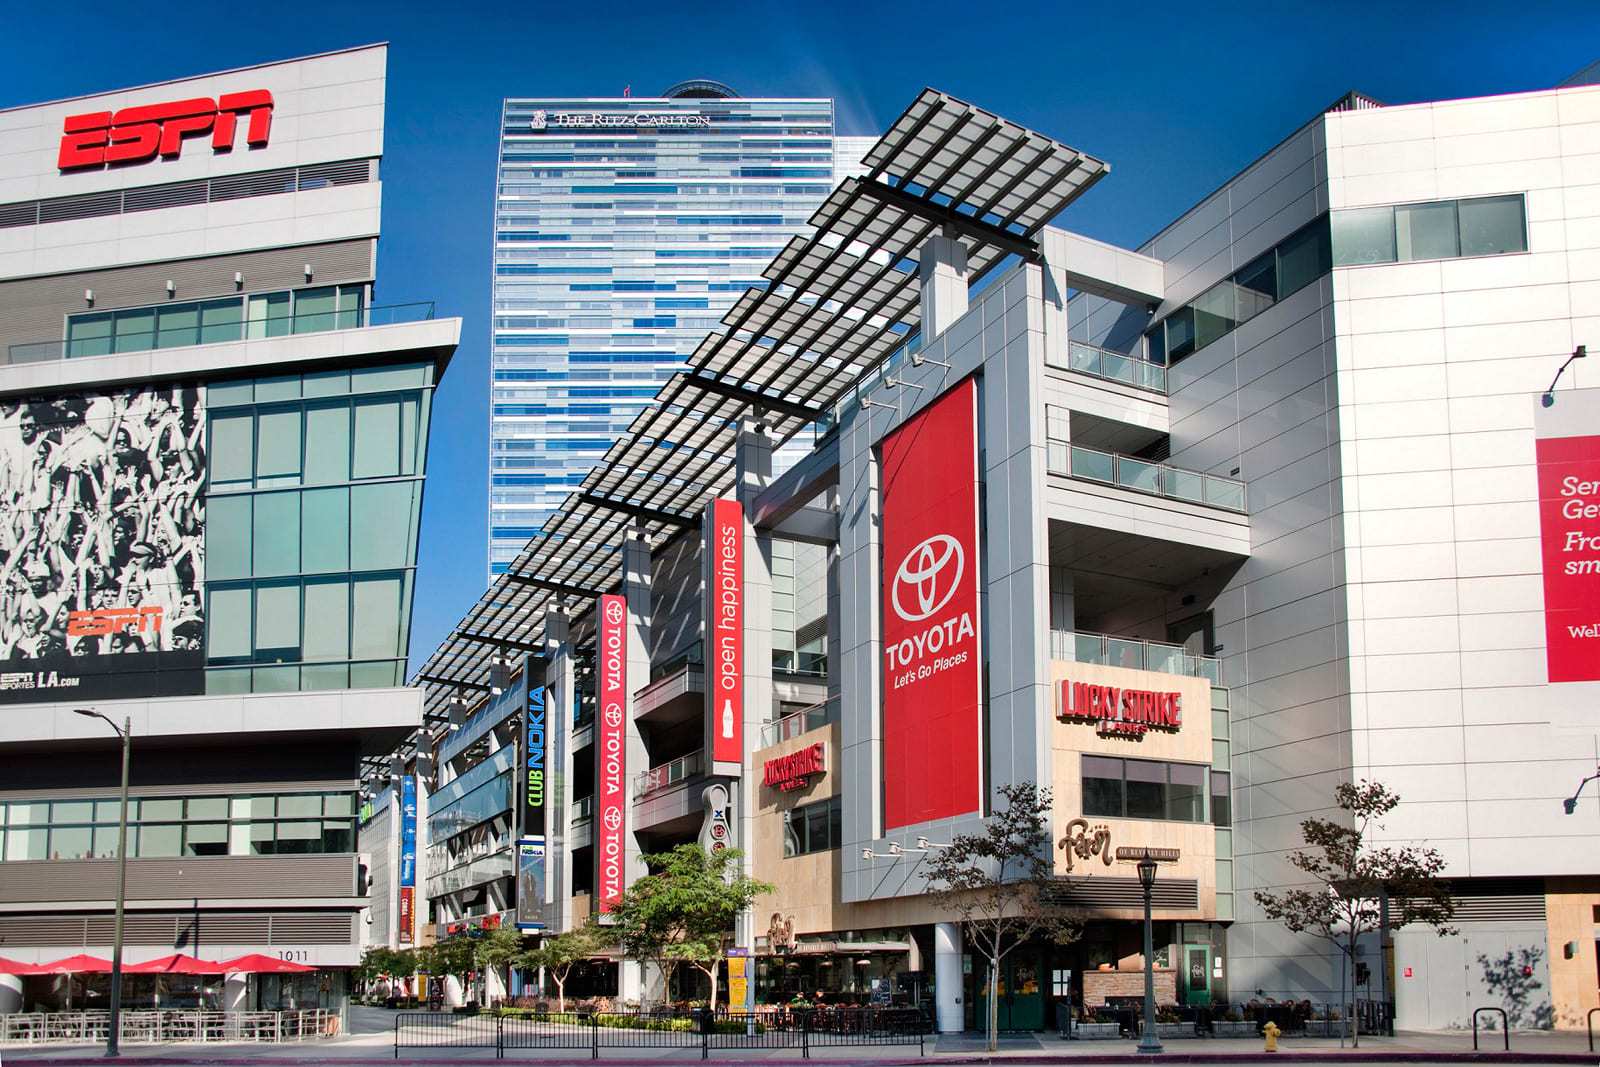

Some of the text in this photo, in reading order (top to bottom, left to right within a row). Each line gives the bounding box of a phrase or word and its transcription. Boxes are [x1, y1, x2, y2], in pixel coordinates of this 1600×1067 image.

[57, 89, 274, 169] ESPN
[554, 112, 711, 126] THE RITZ-CARLTON
[68, 606, 163, 636] ESPN
[718, 525, 739, 690] open happiness
[607, 627, 621, 691] TOYOTA
[886, 612, 975, 671] TOYOTA
[894, 651, 968, 689] Let's Go Places
[1056, 680, 1182, 726] LUCKY STRIKE
[1099, 720, 1148, 733] LANES
[528, 686, 545, 806] CLUB NOKIA
[606, 729, 620, 795] TOYOTA
[605, 832, 619, 900] TOYOTA
[279, 951, 308, 961] 1011
